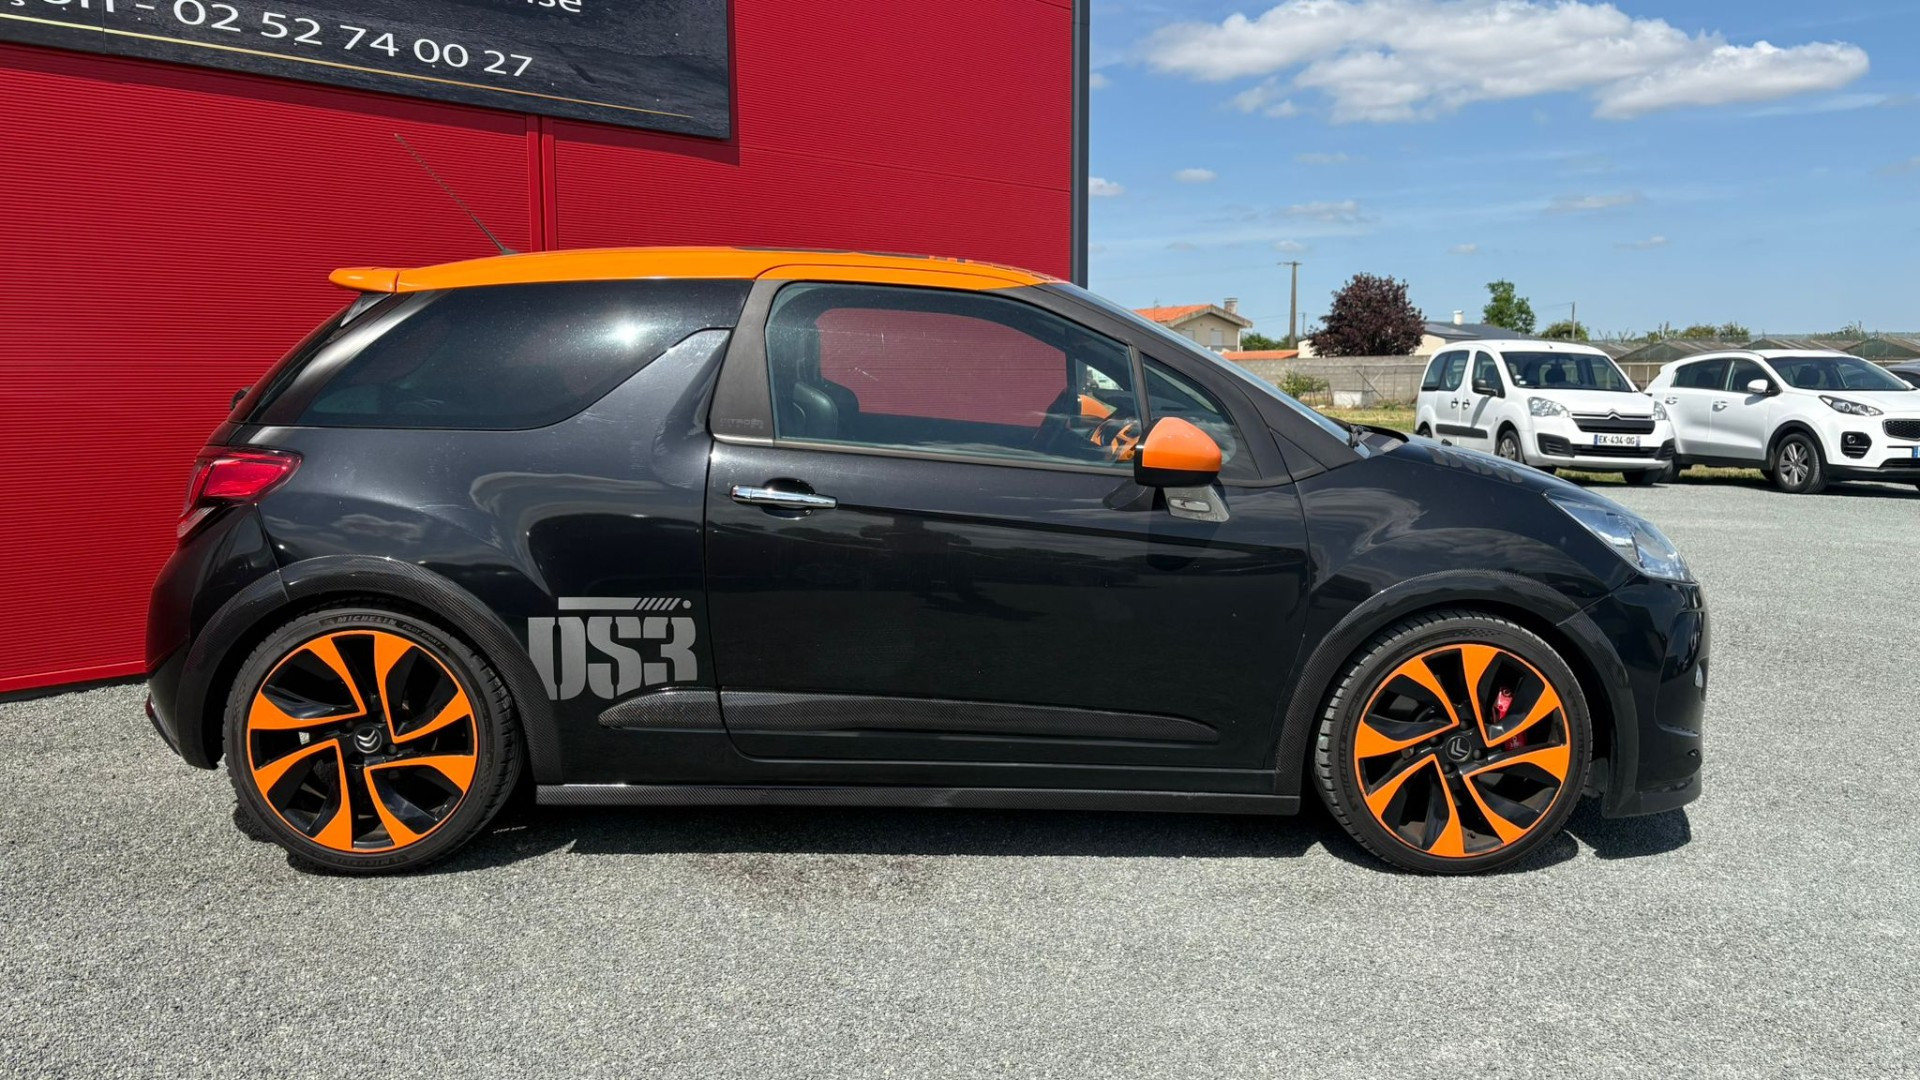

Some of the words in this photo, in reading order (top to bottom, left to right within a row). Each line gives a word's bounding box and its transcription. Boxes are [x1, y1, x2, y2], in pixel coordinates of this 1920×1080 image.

[173, 0, 241, 32] 02
[261, 11, 322, 45] 52
[340, 24, 399, 57] 74
[413, 38, 469, 68] 00
[483, 50, 533, 77] 27
[337, 615, 397, 625] MICHELIN
[527, 616, 698, 700] DS3
